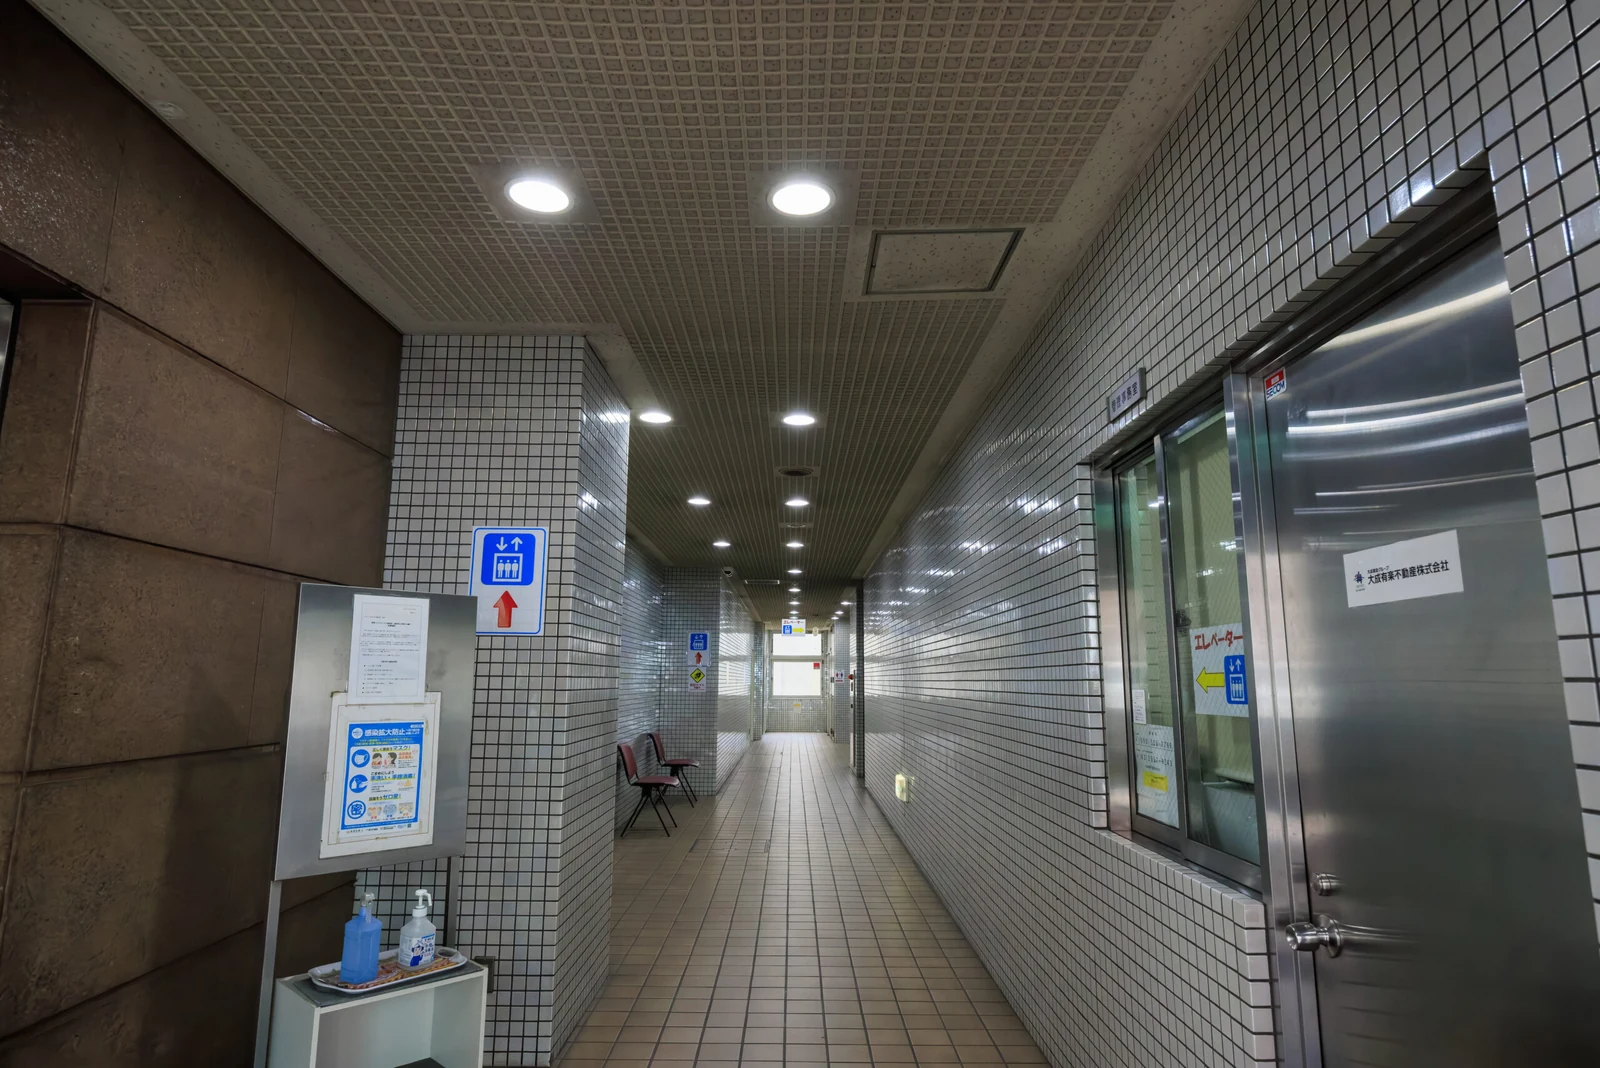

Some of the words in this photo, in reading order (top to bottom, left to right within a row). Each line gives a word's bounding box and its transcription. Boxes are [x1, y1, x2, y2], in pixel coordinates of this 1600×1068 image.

[1266, 381, 1285, 399] SECOM
[1367, 560, 1449, 584] 大成有楽不動産株式会社
[1194, 630, 1244, 650] エレベーター
[364, 728, 406, 736] 感染拡大防止
